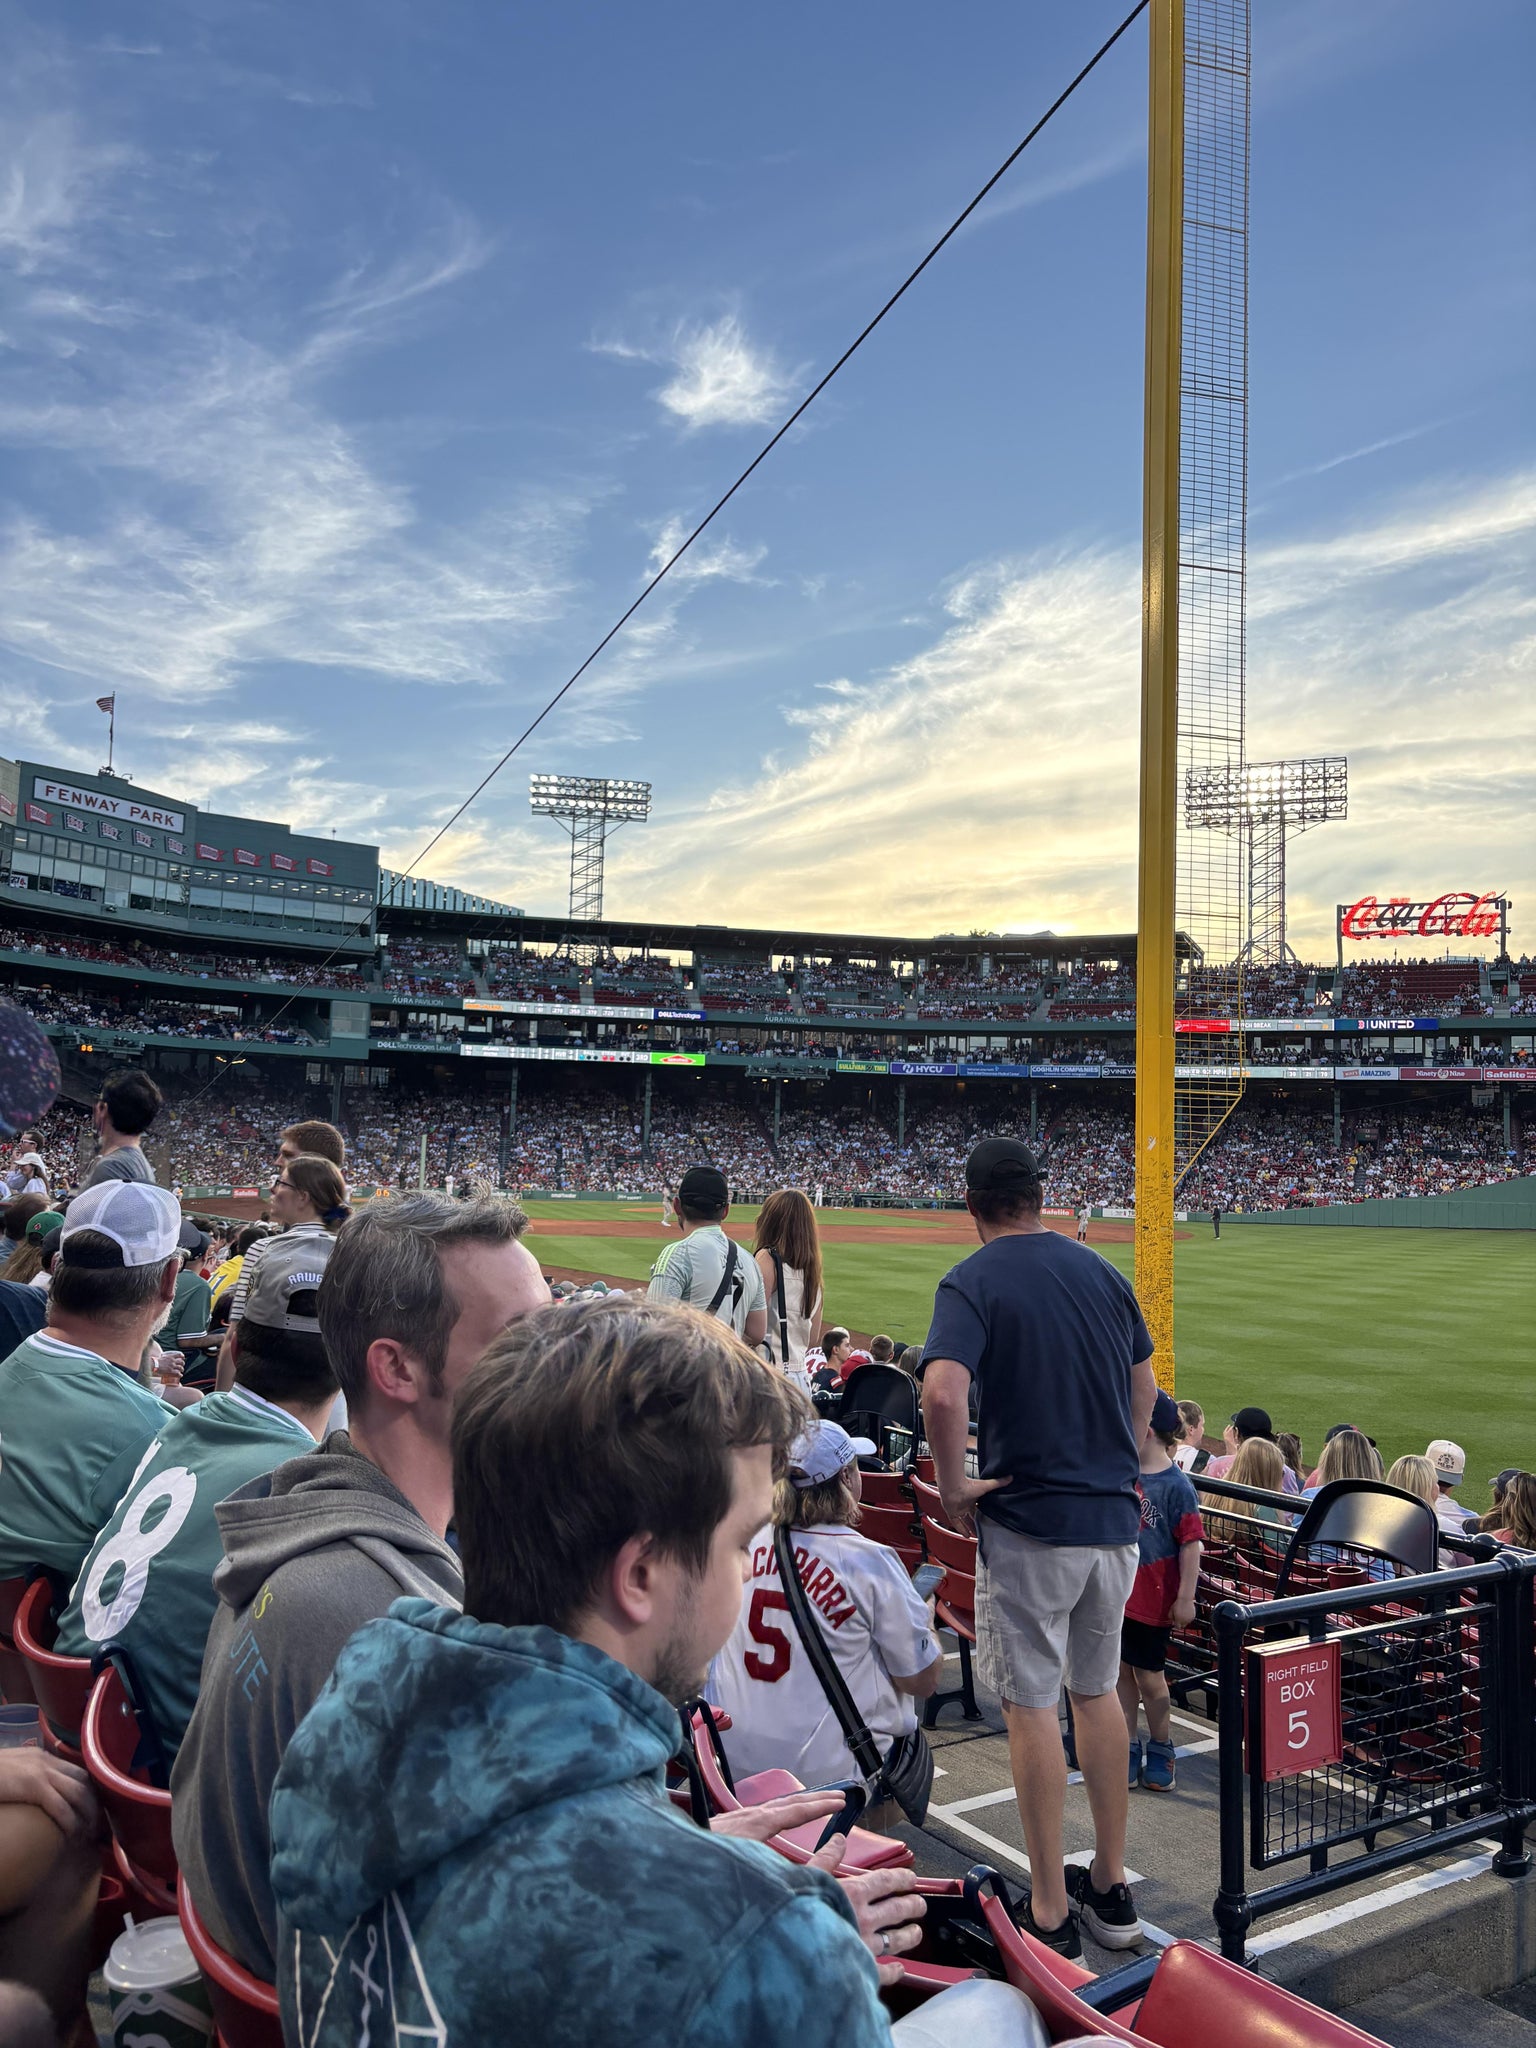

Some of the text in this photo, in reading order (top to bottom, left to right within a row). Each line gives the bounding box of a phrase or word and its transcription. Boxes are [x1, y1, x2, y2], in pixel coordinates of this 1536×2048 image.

[46, 785, 175, 827] FENWAY PARK
[1342, 891, 1507, 940] Coca-Cola
[1370, 1020, 1415, 1029] UNITED
[377, 1041, 396, 1049] DELL
[396, 1042, 434, 1051] Technologies
[839, 1061, 866, 1071] SULLIVAN
[916, 1065, 942, 1073] HYCU
[1060, 1066, 1099, 1074] COMPANIES
[1360, 1069, 1391, 1077] AMAZING
[1416, 1070, 1437, 1078] Ninety
[1486, 1069, 1525, 1079] Safelite
[1042, 1208, 1070, 1216] Safelite
[752, 1544, 857, 1631] CIPARRA
[744, 1588, 791, 1683] 5
[1267, 1660, 1329, 1683] RIGHT FIELD
[1280, 1679, 1316, 1703] BOX
[1287, 1709, 1310, 1749] 5
